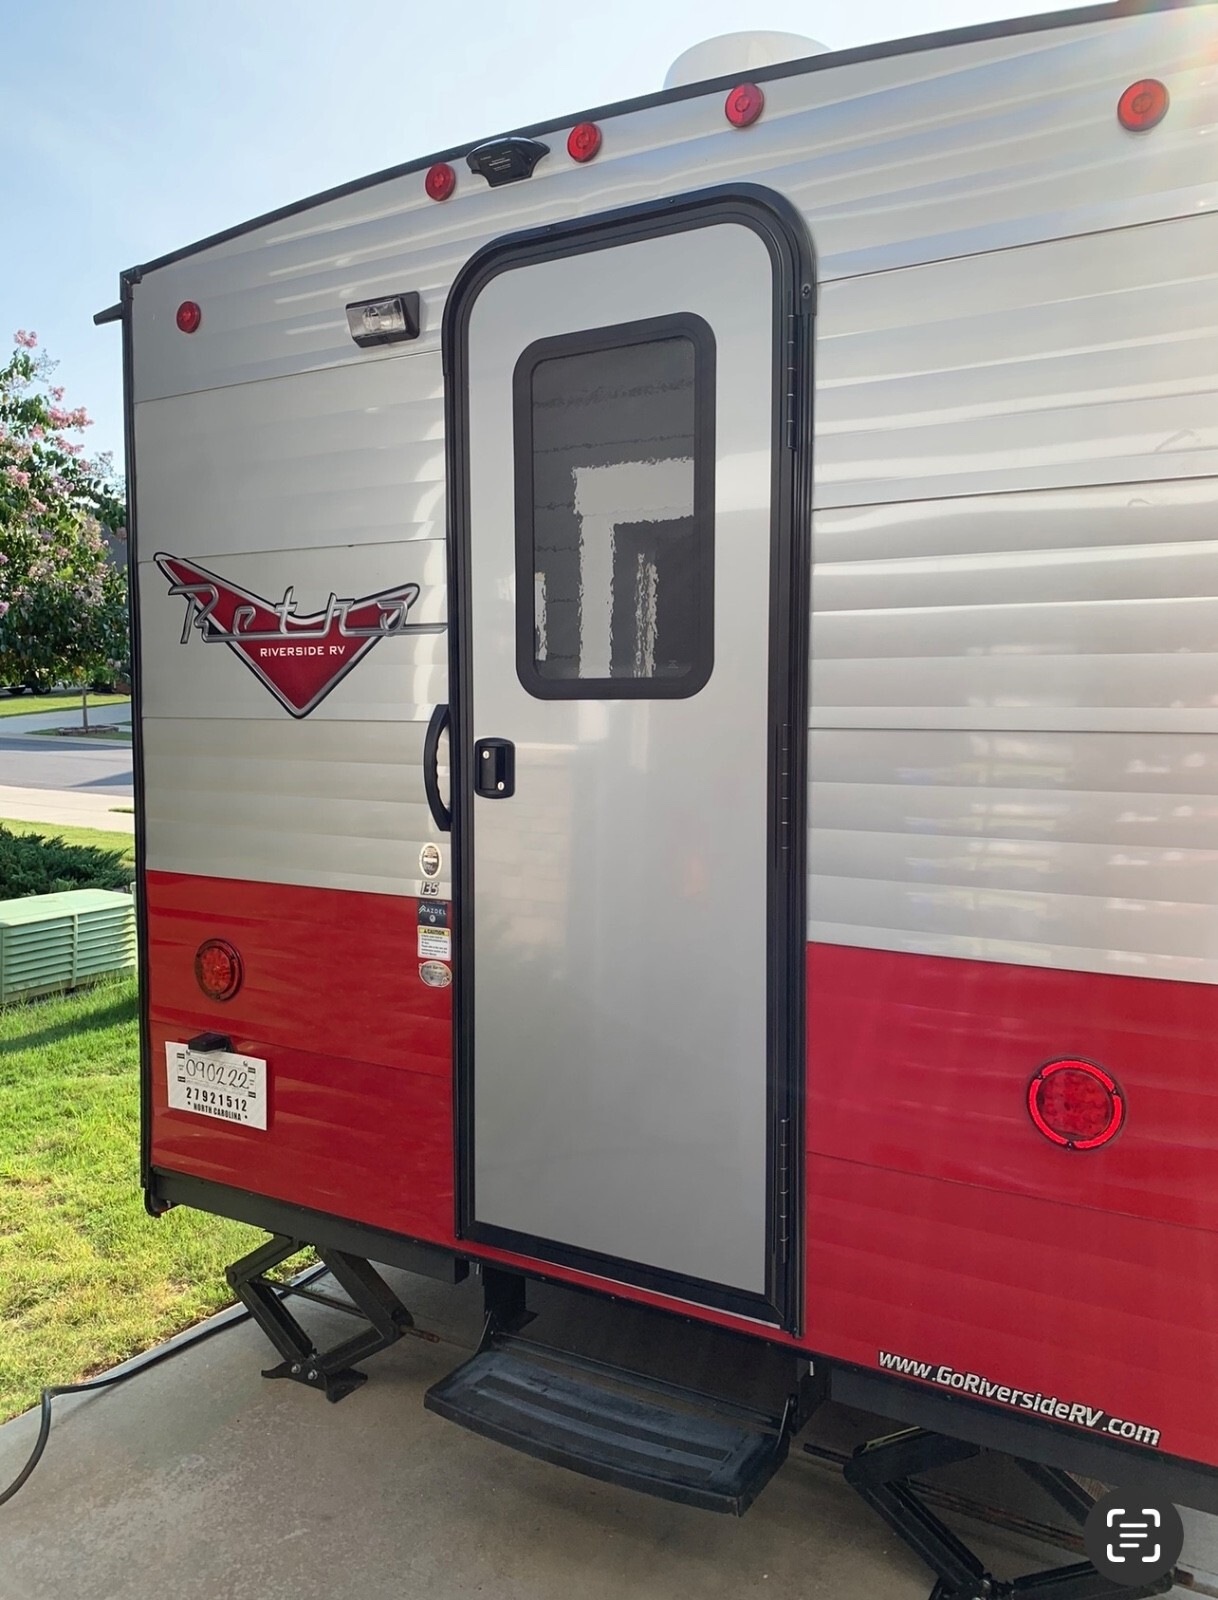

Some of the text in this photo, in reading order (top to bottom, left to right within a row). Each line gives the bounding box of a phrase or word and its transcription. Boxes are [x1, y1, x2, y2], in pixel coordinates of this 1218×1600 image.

[260, 645, 346, 657] RIVERSIDE RV
[186, 1059, 249, 1090] 090222
[186, 1087, 247, 1112] 27921512
[194, 1103, 241, 1121] NORTH CAROLINA
[878, 1351, 1161, 1445] www.GoRiversideRV.com
